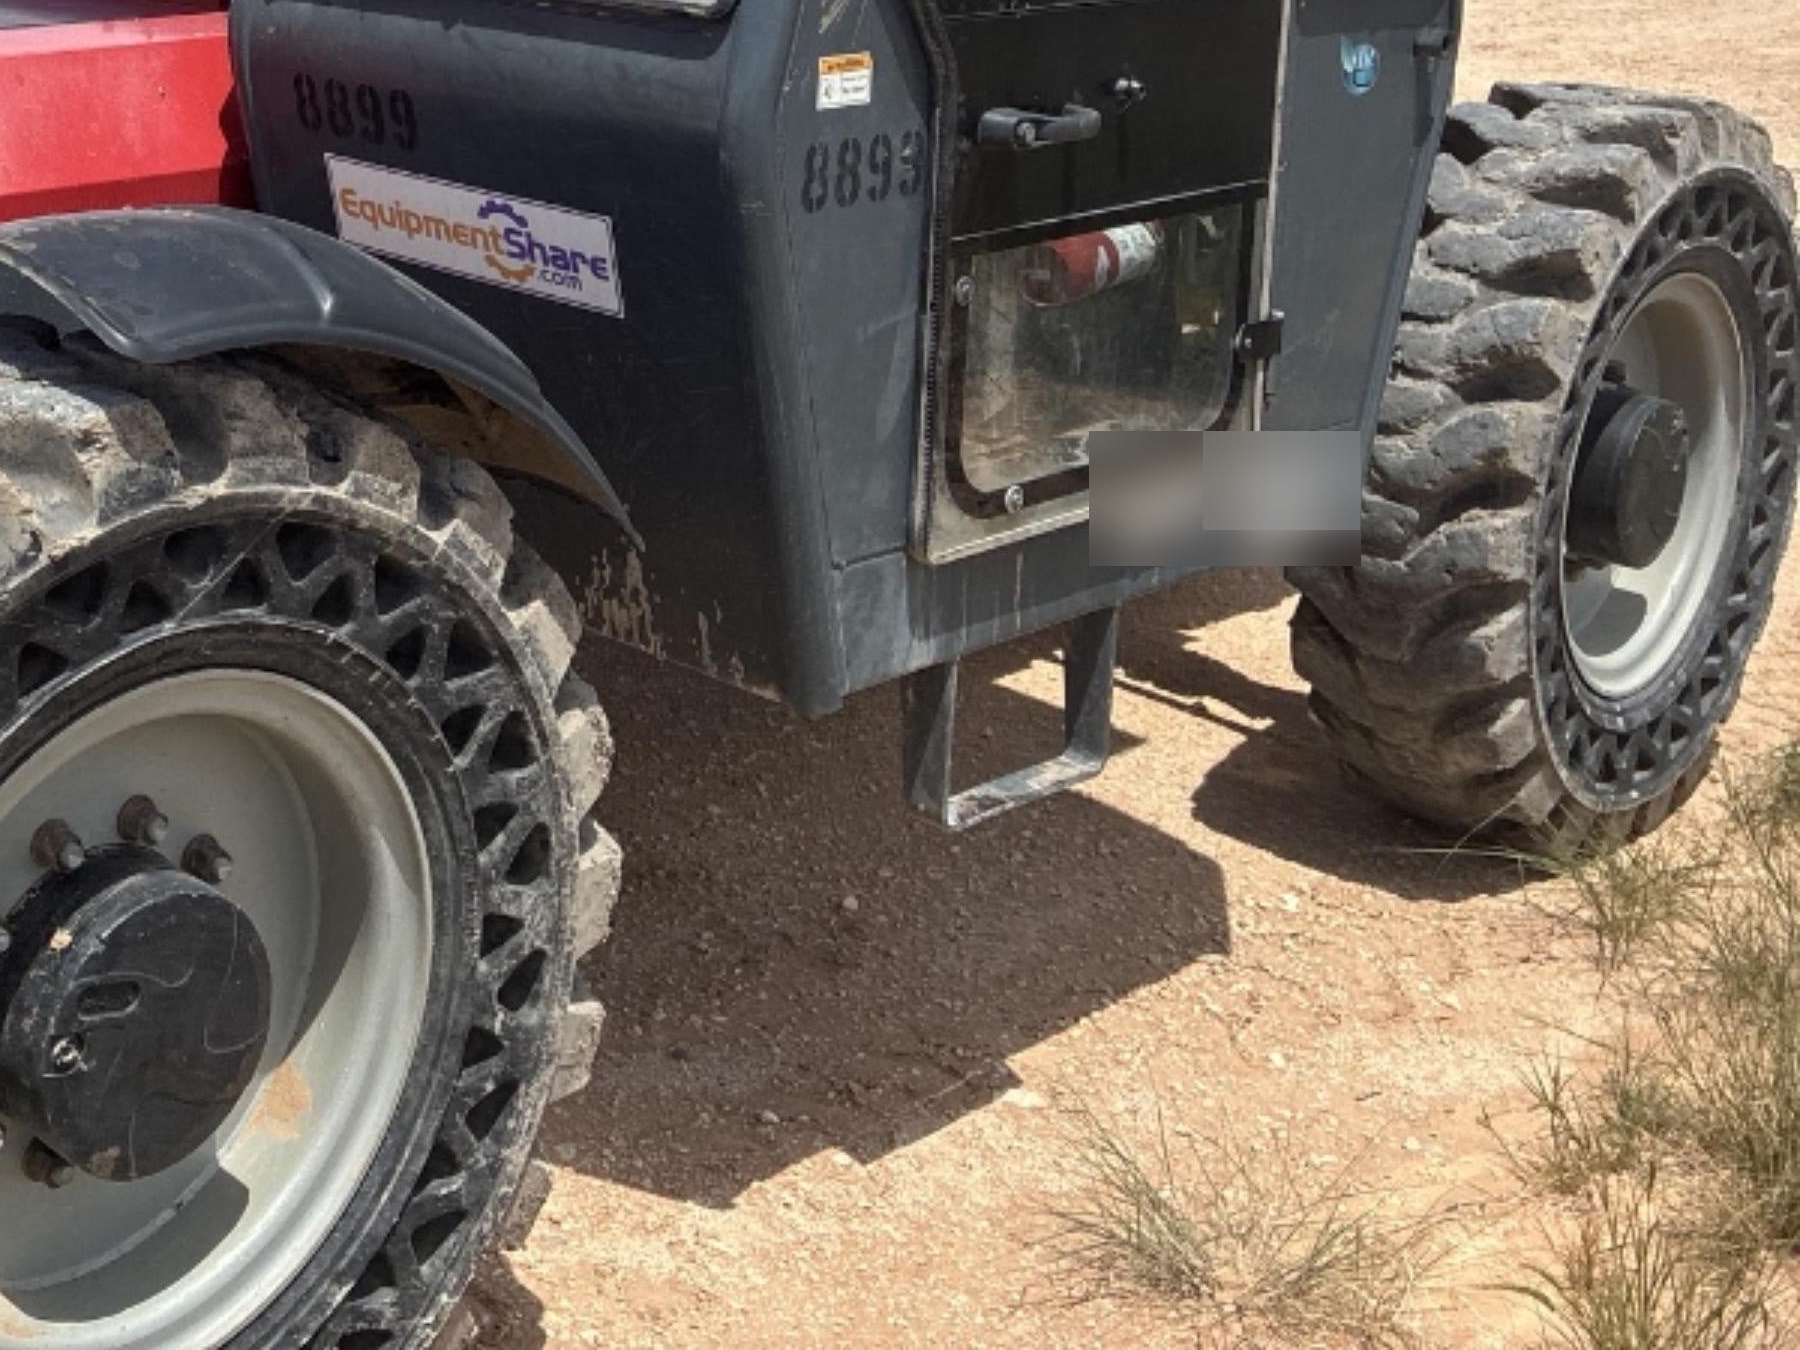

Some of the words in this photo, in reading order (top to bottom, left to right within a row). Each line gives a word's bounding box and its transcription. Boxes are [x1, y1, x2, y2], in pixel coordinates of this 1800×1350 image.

[293, 72, 418, 149] 8899
[338, 187, 609, 282] EquipmentShare
[538, 269, 583, 291] .com
